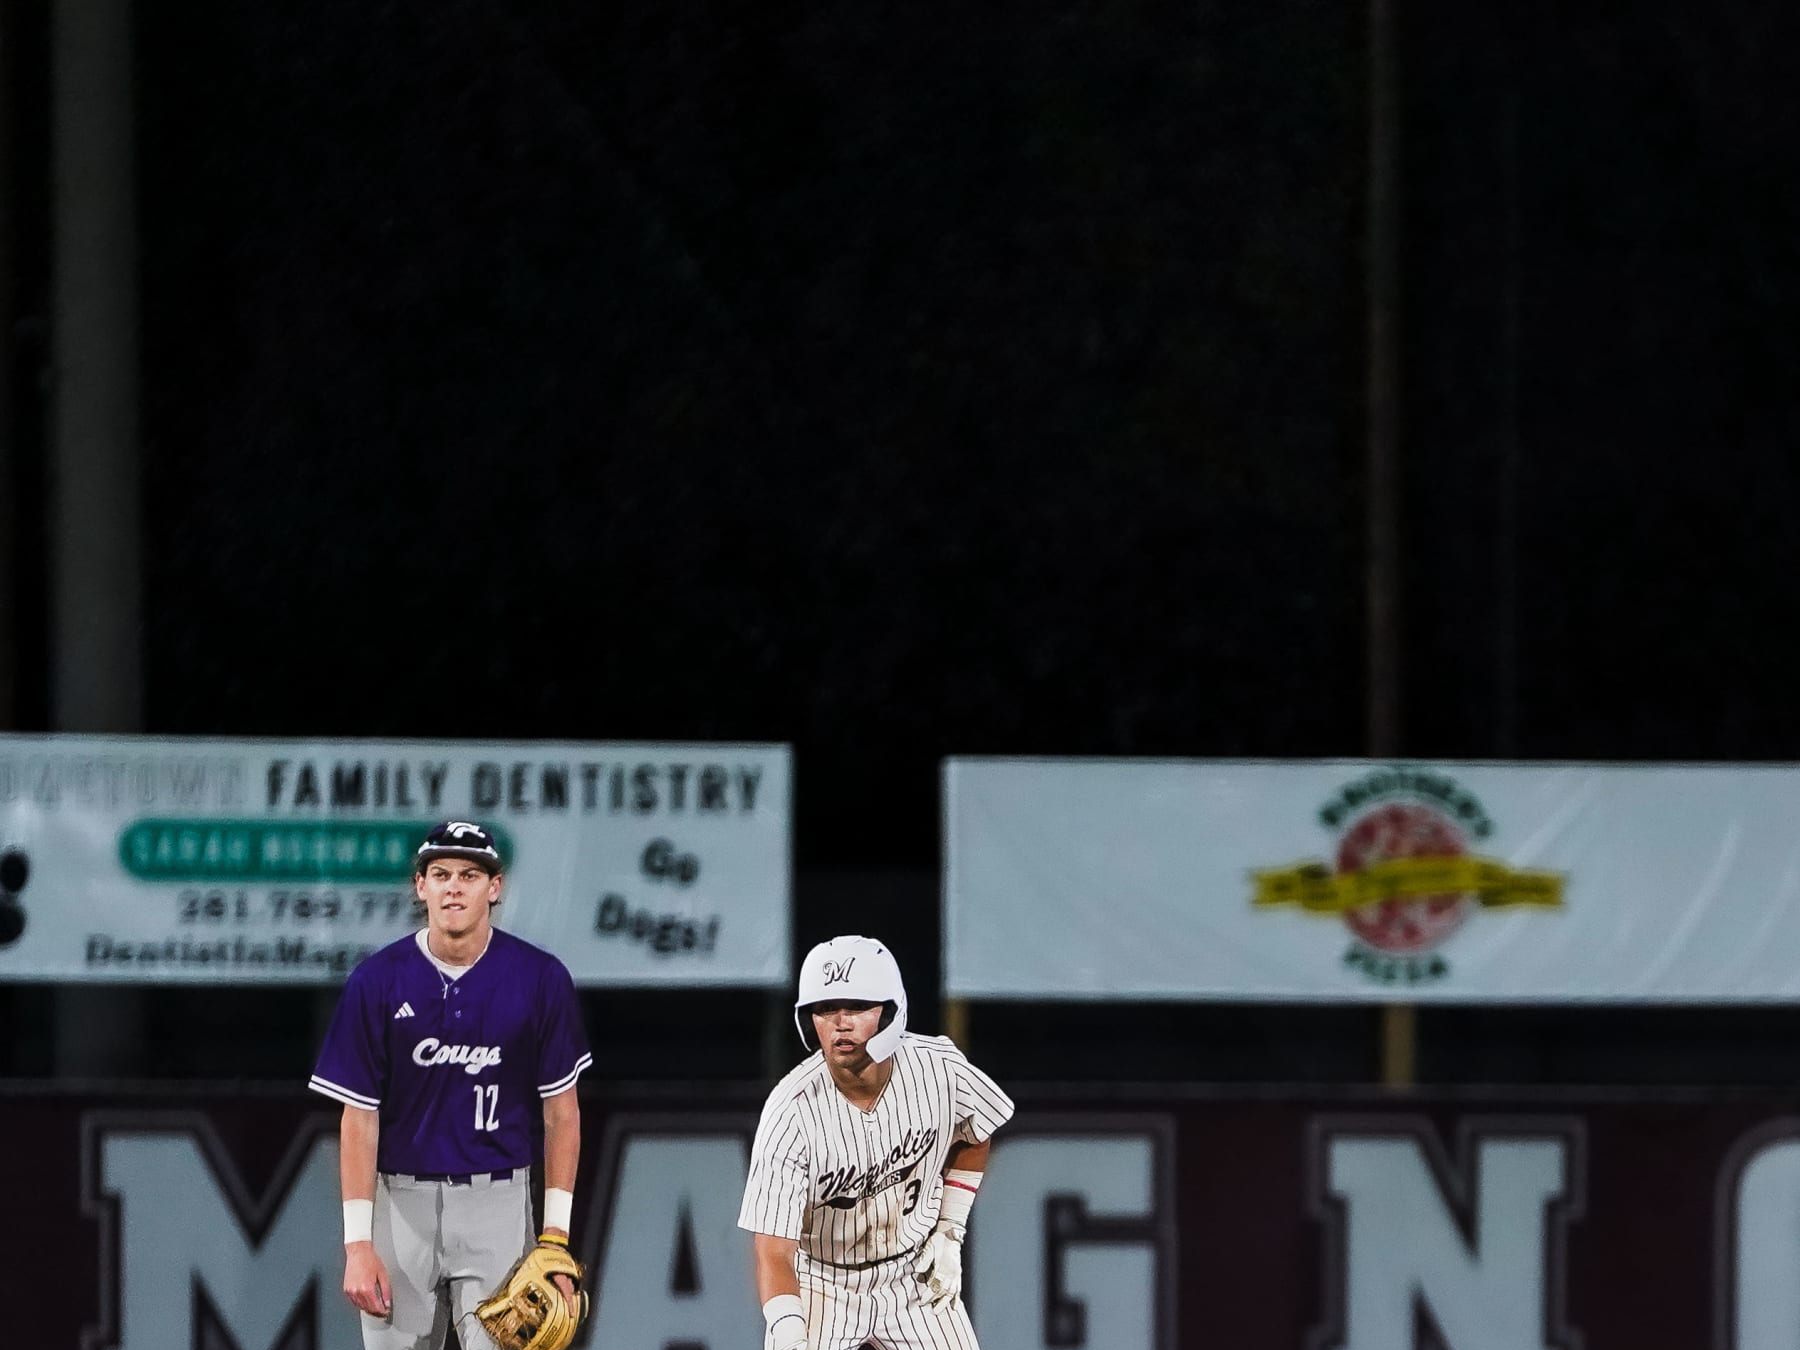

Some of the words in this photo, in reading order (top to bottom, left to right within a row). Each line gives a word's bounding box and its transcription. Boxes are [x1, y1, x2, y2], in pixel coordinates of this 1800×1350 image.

[265, 757, 449, 808] FAMILY
[470, 761, 765, 815] DENTISTRY
[641, 837, 701, 888] Go
[595, 893, 721, 957] Dogs!
[823, 956, 856, 986] M
[412, 1037, 502, 1075] Cougs
[473, 1084, 500, 1132] 12
[817, 1127, 938, 1201] Magnolia
[902, 1178, 922, 1216] 3
